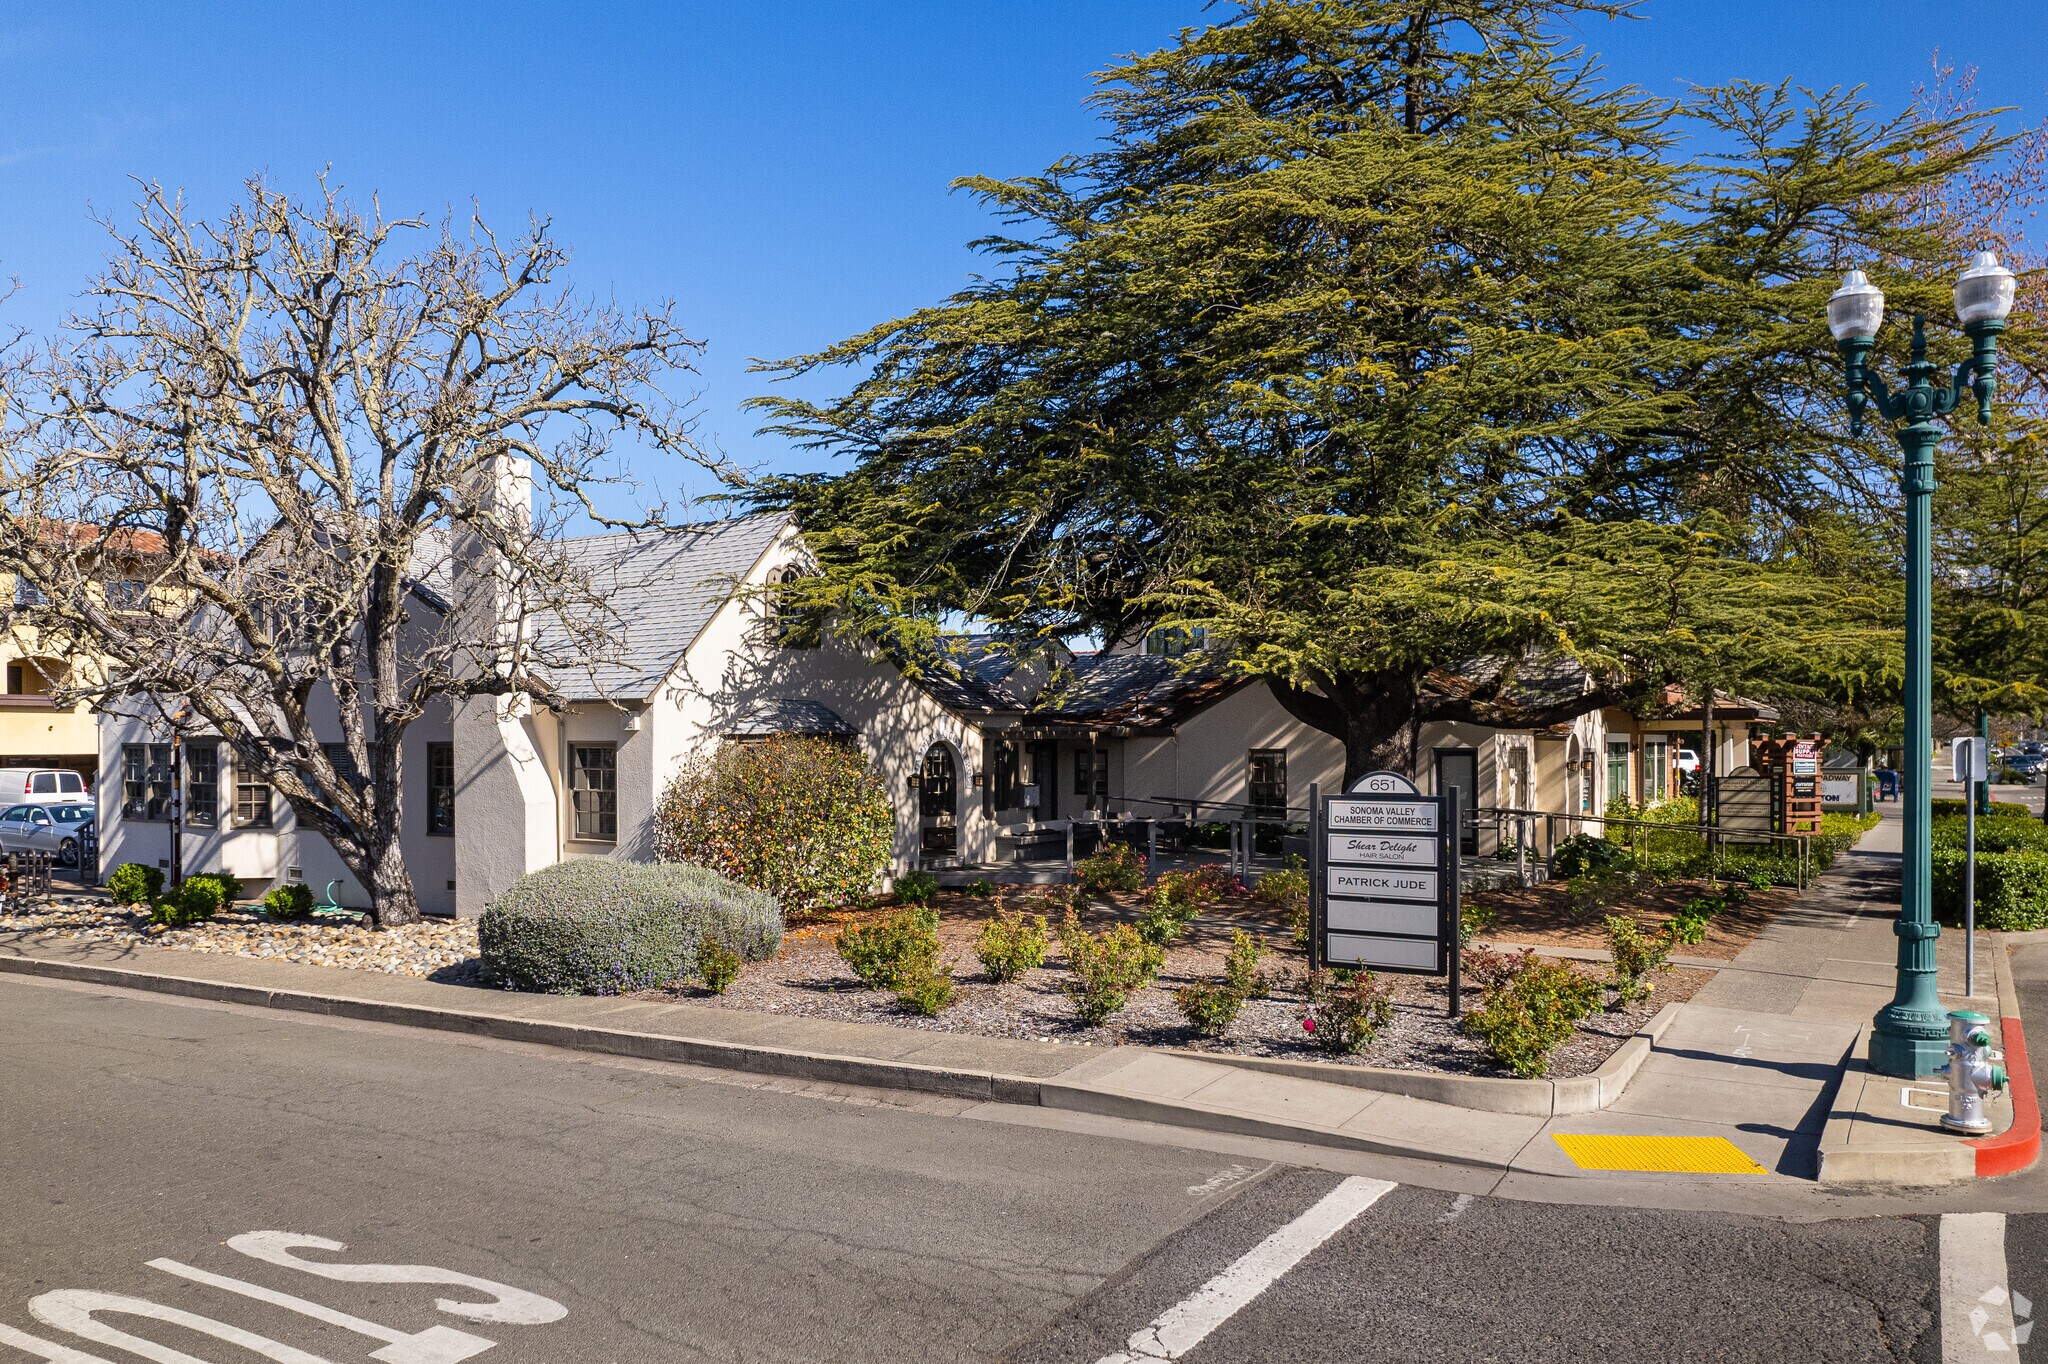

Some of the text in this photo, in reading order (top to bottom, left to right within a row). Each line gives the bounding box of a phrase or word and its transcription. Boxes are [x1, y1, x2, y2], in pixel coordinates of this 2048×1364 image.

[1821, 774, 1851, 782] ADWAY
[1370, 779, 1396, 791] 651
[1350, 806, 1416, 816] SONOMA VALLEY
[1334, 815, 1432, 826] CHAMBER OF COMMERCE
[1347, 840, 1417, 854] Shear Delight
[1378, 852, 1405, 860] SALON
[1338, 876, 1427, 890] PATRICK JUDE
